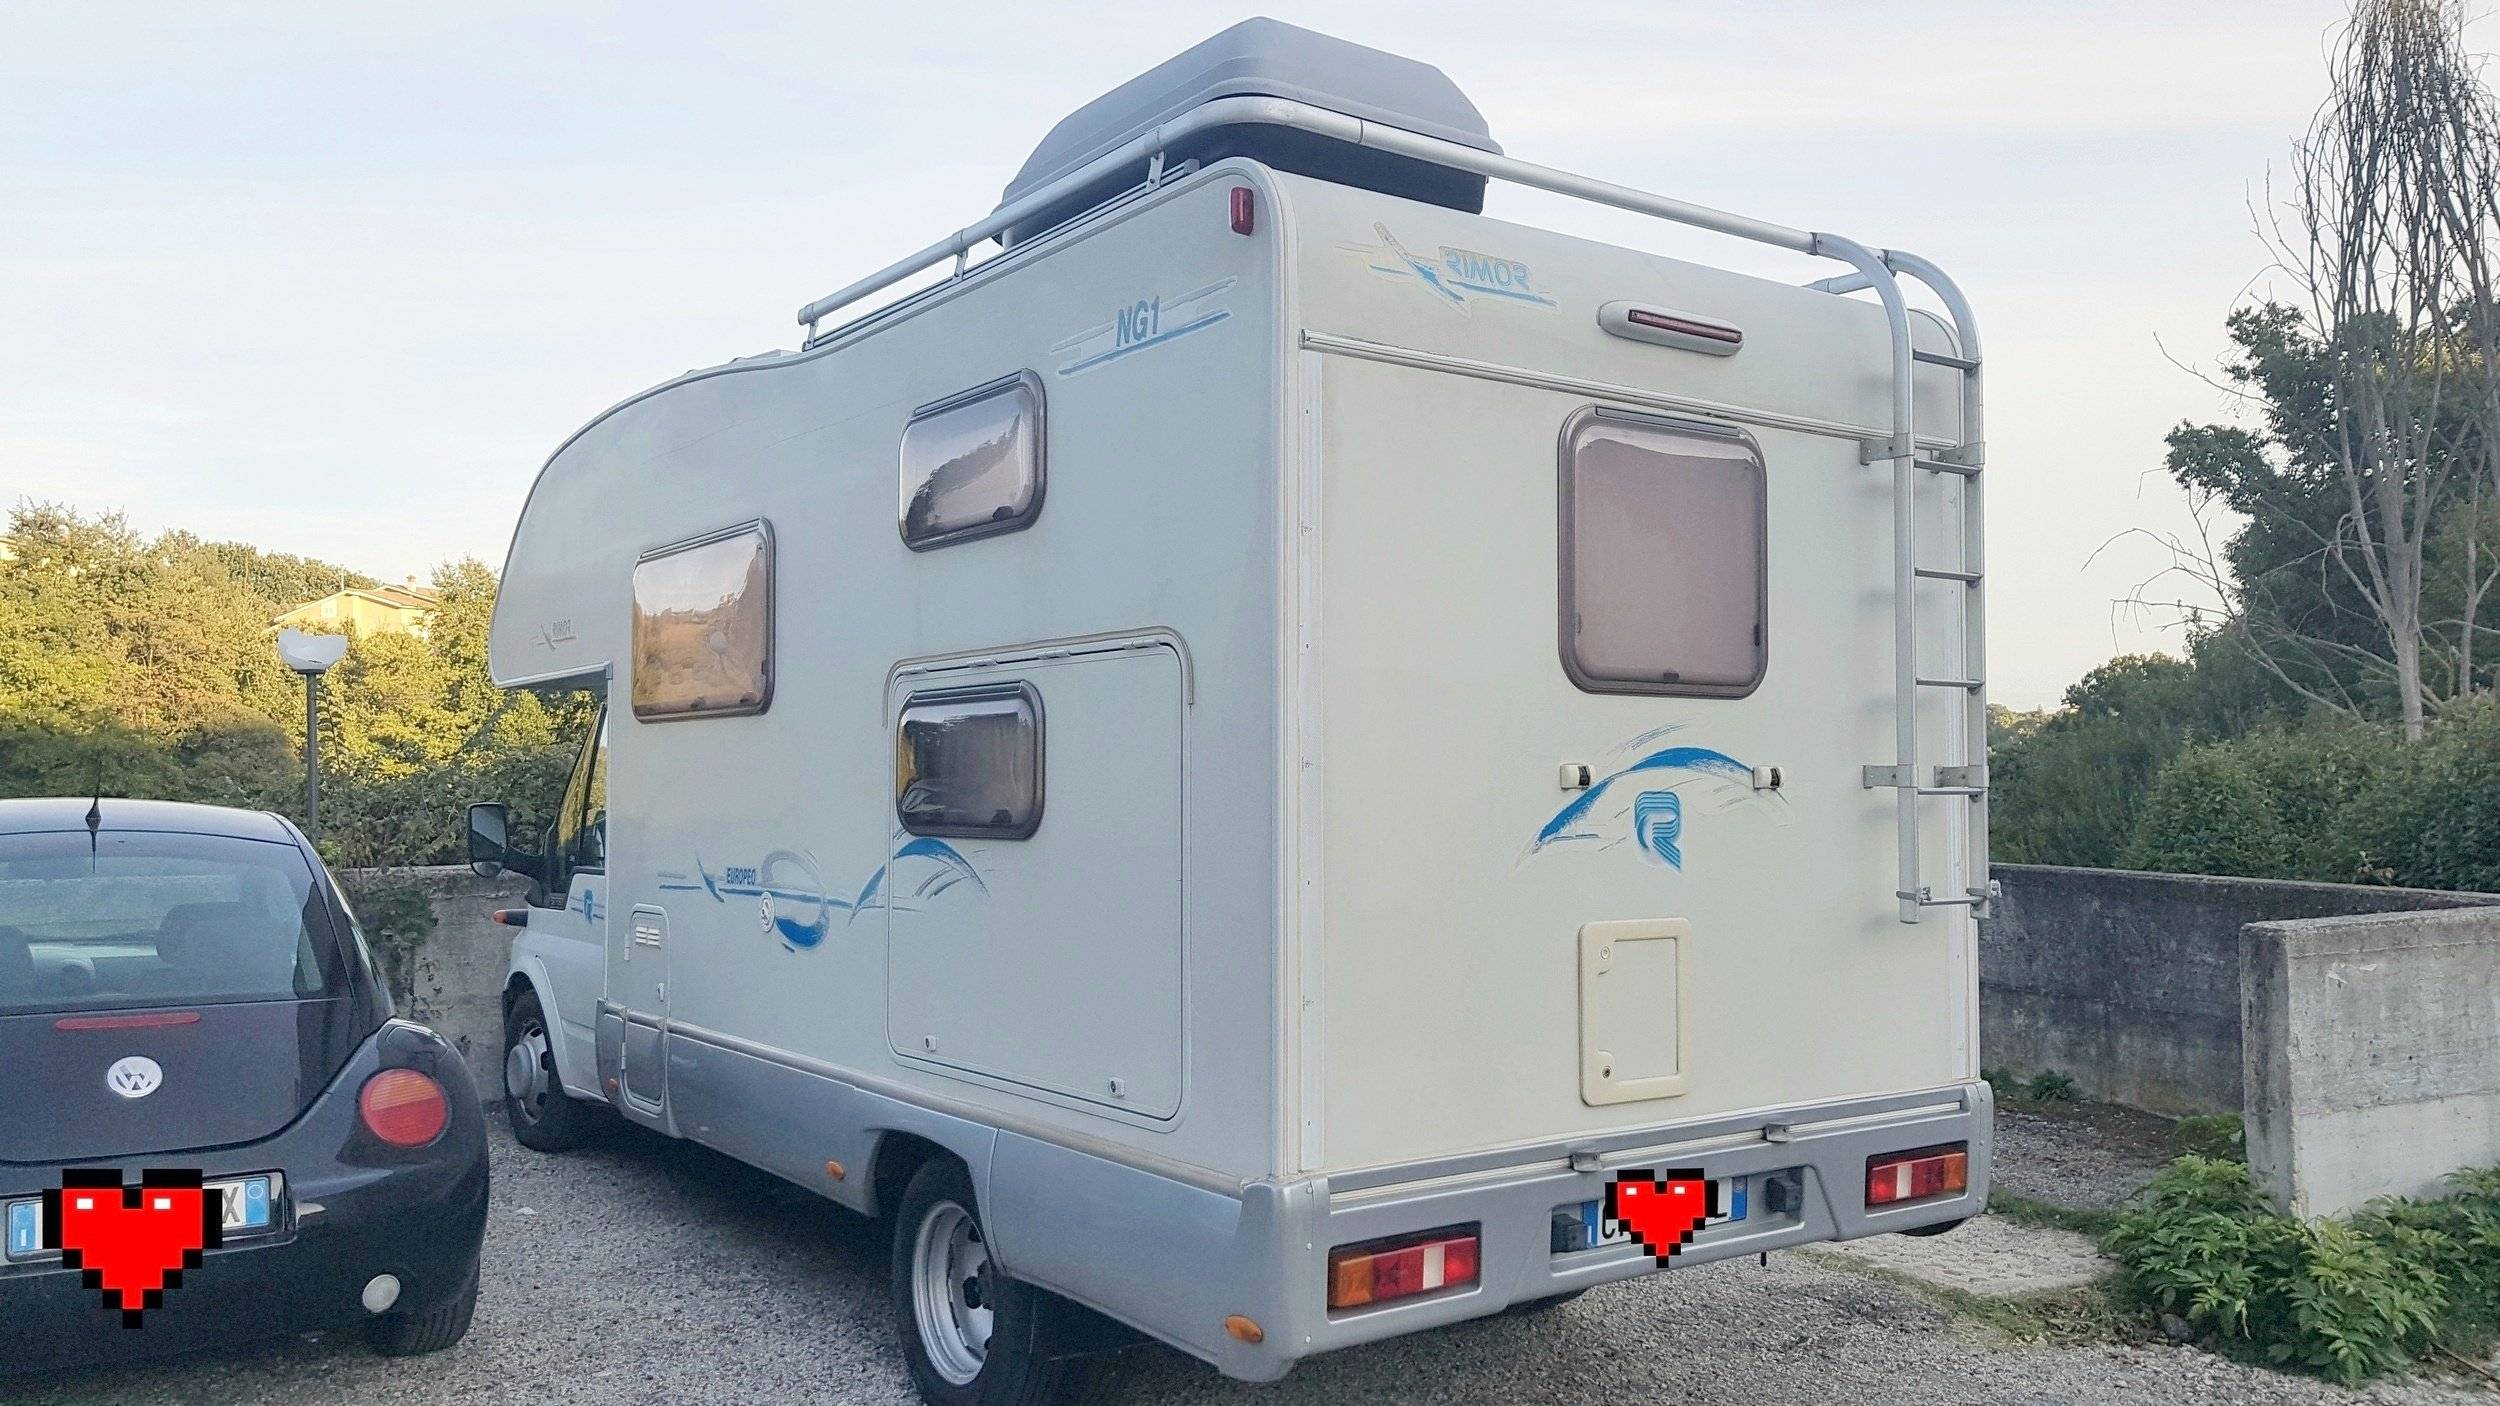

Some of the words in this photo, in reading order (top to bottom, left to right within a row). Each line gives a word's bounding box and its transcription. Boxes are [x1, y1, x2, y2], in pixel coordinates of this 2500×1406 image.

[1445, 249, 1531, 291] RIMOR
[1116, 296, 1160, 347] NG1
[727, 867, 756, 886] EUROPEO
